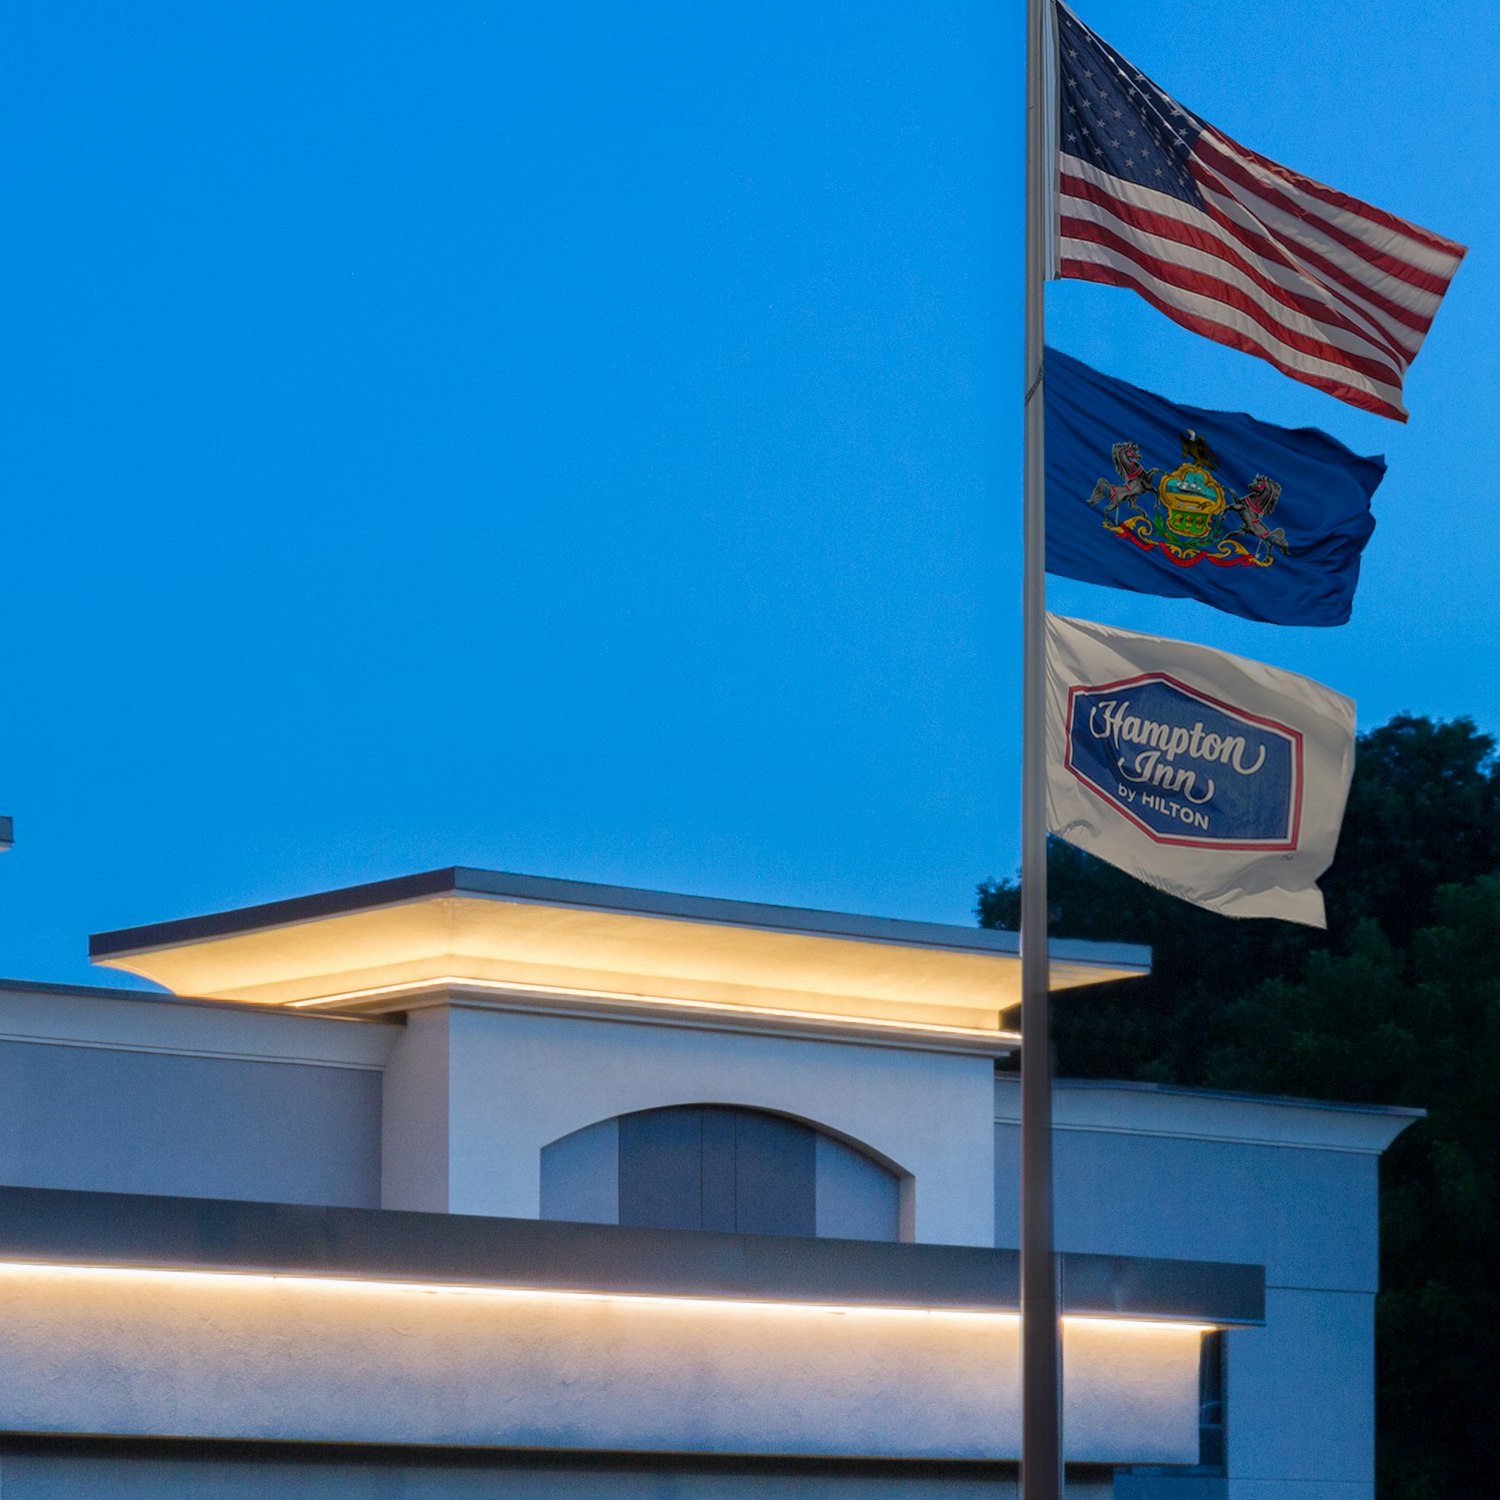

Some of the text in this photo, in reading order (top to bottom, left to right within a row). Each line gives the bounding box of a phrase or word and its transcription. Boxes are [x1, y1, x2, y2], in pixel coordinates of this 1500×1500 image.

[1088, 700, 1267, 776] Hampton
[1116, 750, 1216, 804] Inn
[1117, 782, 1210, 831] by HILTON
